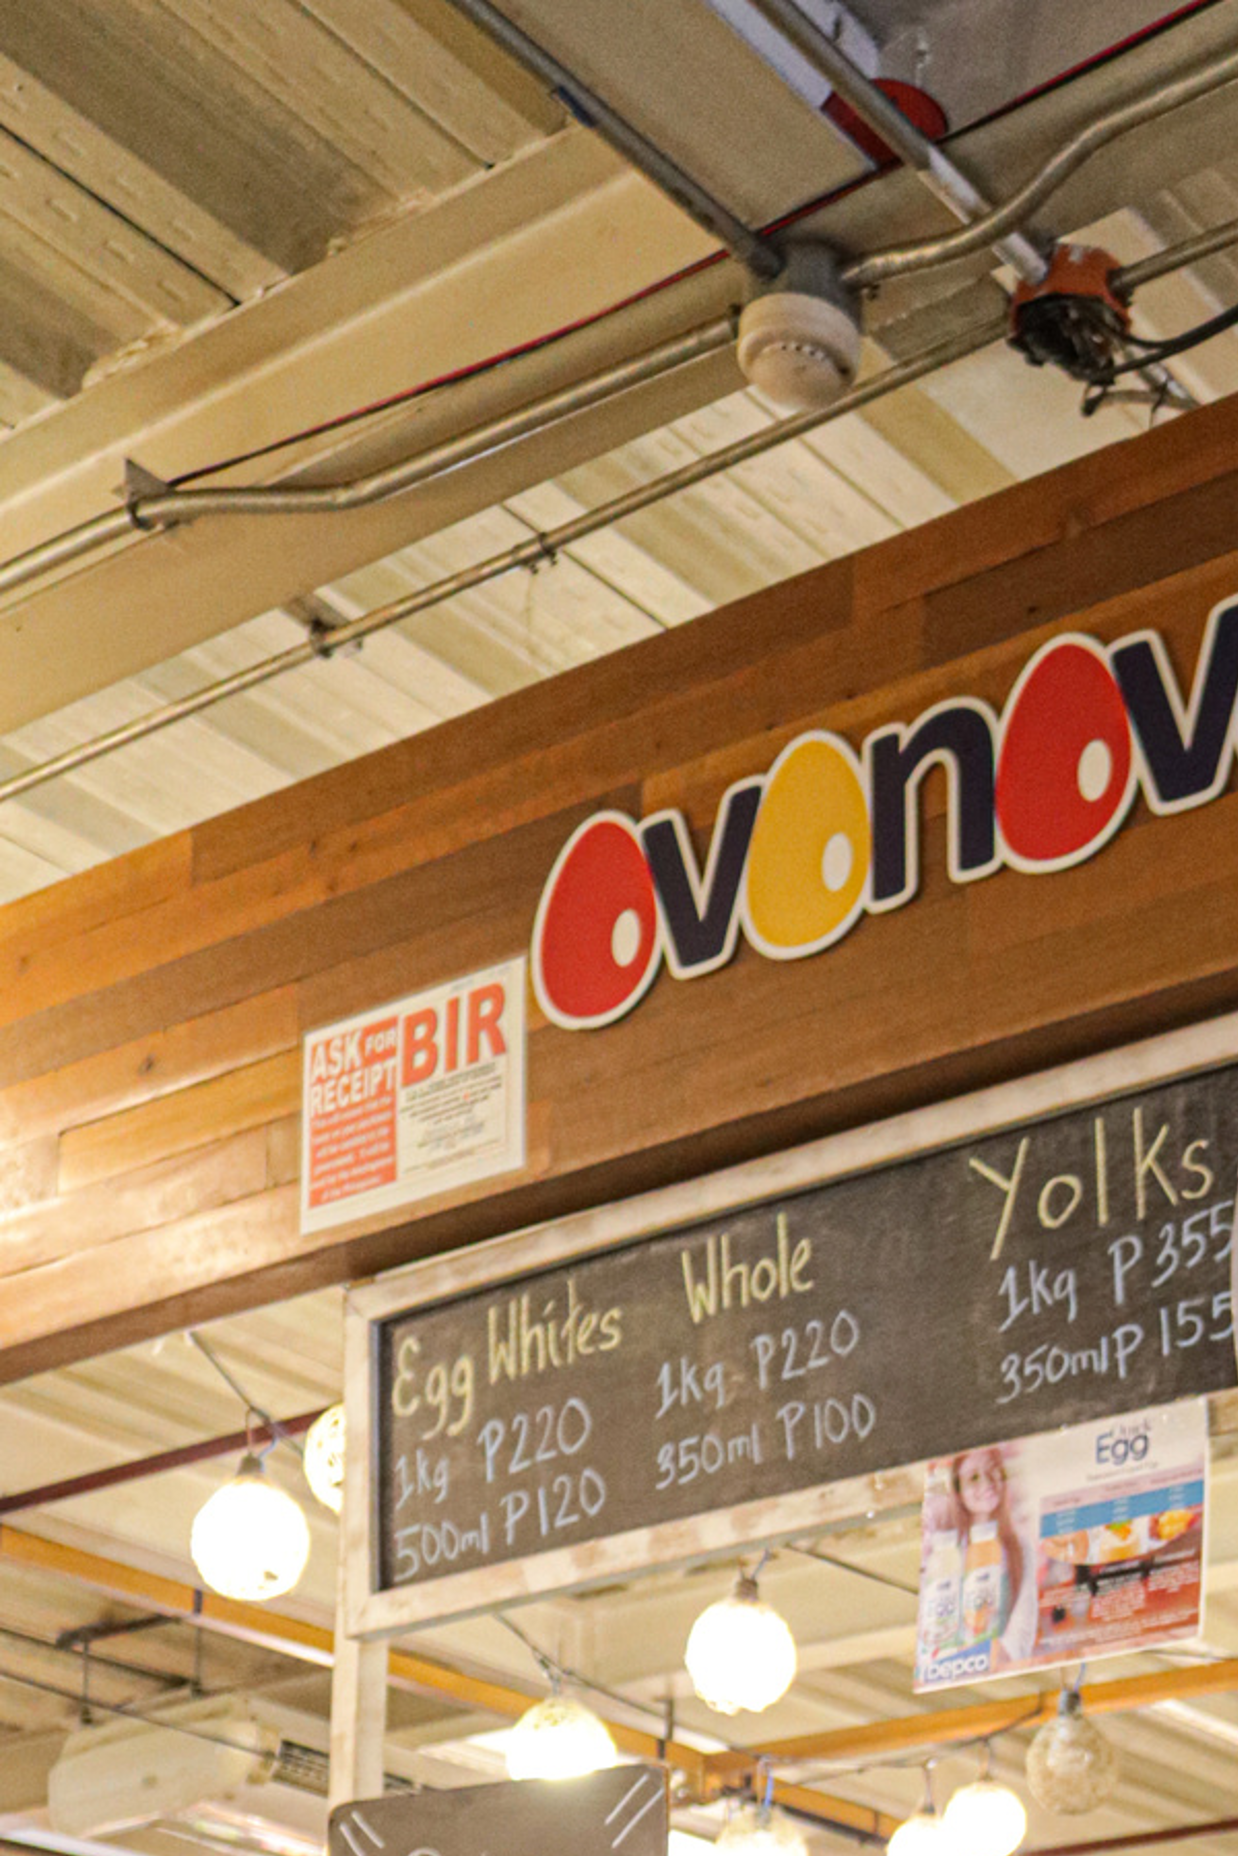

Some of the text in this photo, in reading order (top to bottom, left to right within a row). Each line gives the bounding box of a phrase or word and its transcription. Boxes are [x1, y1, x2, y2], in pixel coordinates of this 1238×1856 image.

[310, 1029, 397, 1085] ASK FOR
[402, 982, 507, 1089] BIR
[310, 1060, 398, 1119] RECEIPT
[681, 1212, 815, 1324] Whole
[391, 1278, 623, 1441] Egg Whites
[750, 1309, 860, 1391] P220
[476, 1396, 593, 1484] P220
[655, 1392, 875, 1491] 350ml P100
[1095, 1431, 1150, 1466] Egg
[393, 1466, 607, 1584] 500ml P120
